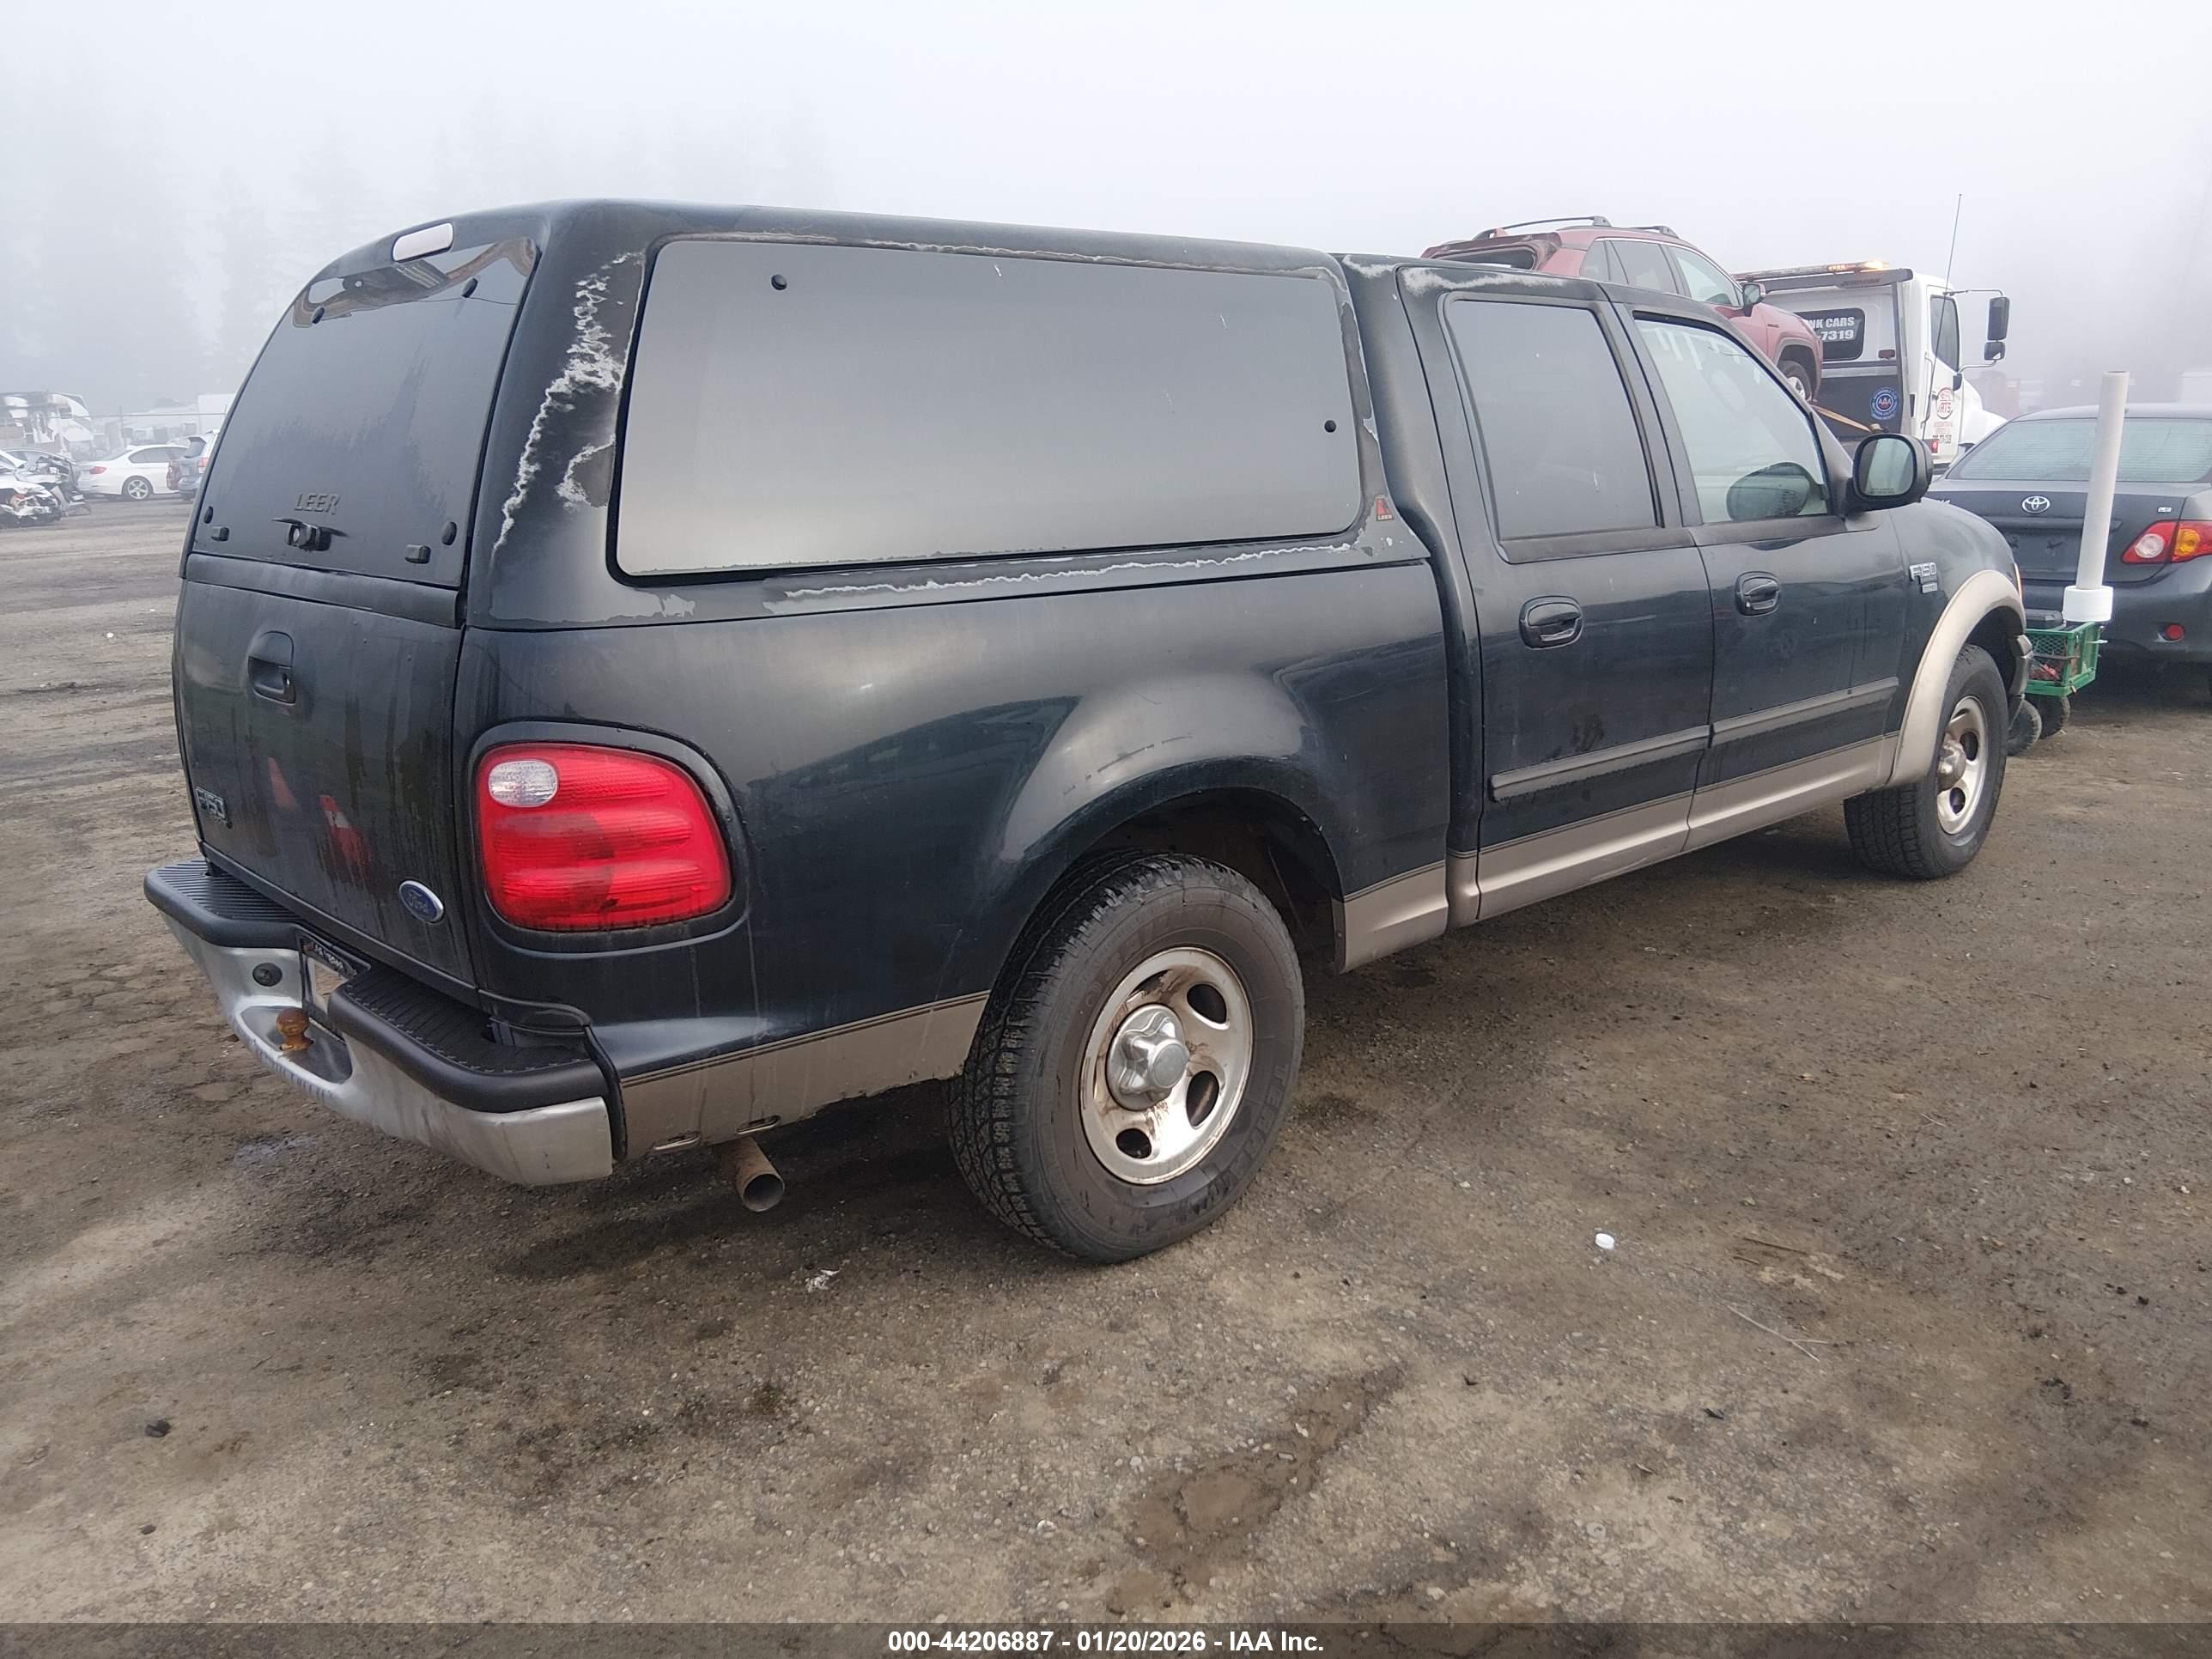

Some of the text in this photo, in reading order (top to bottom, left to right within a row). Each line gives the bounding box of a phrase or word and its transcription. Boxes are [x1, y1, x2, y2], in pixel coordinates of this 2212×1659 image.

[1807, 317, 1855, 329] NK CARS
[294, 494, 341, 515] LEER
